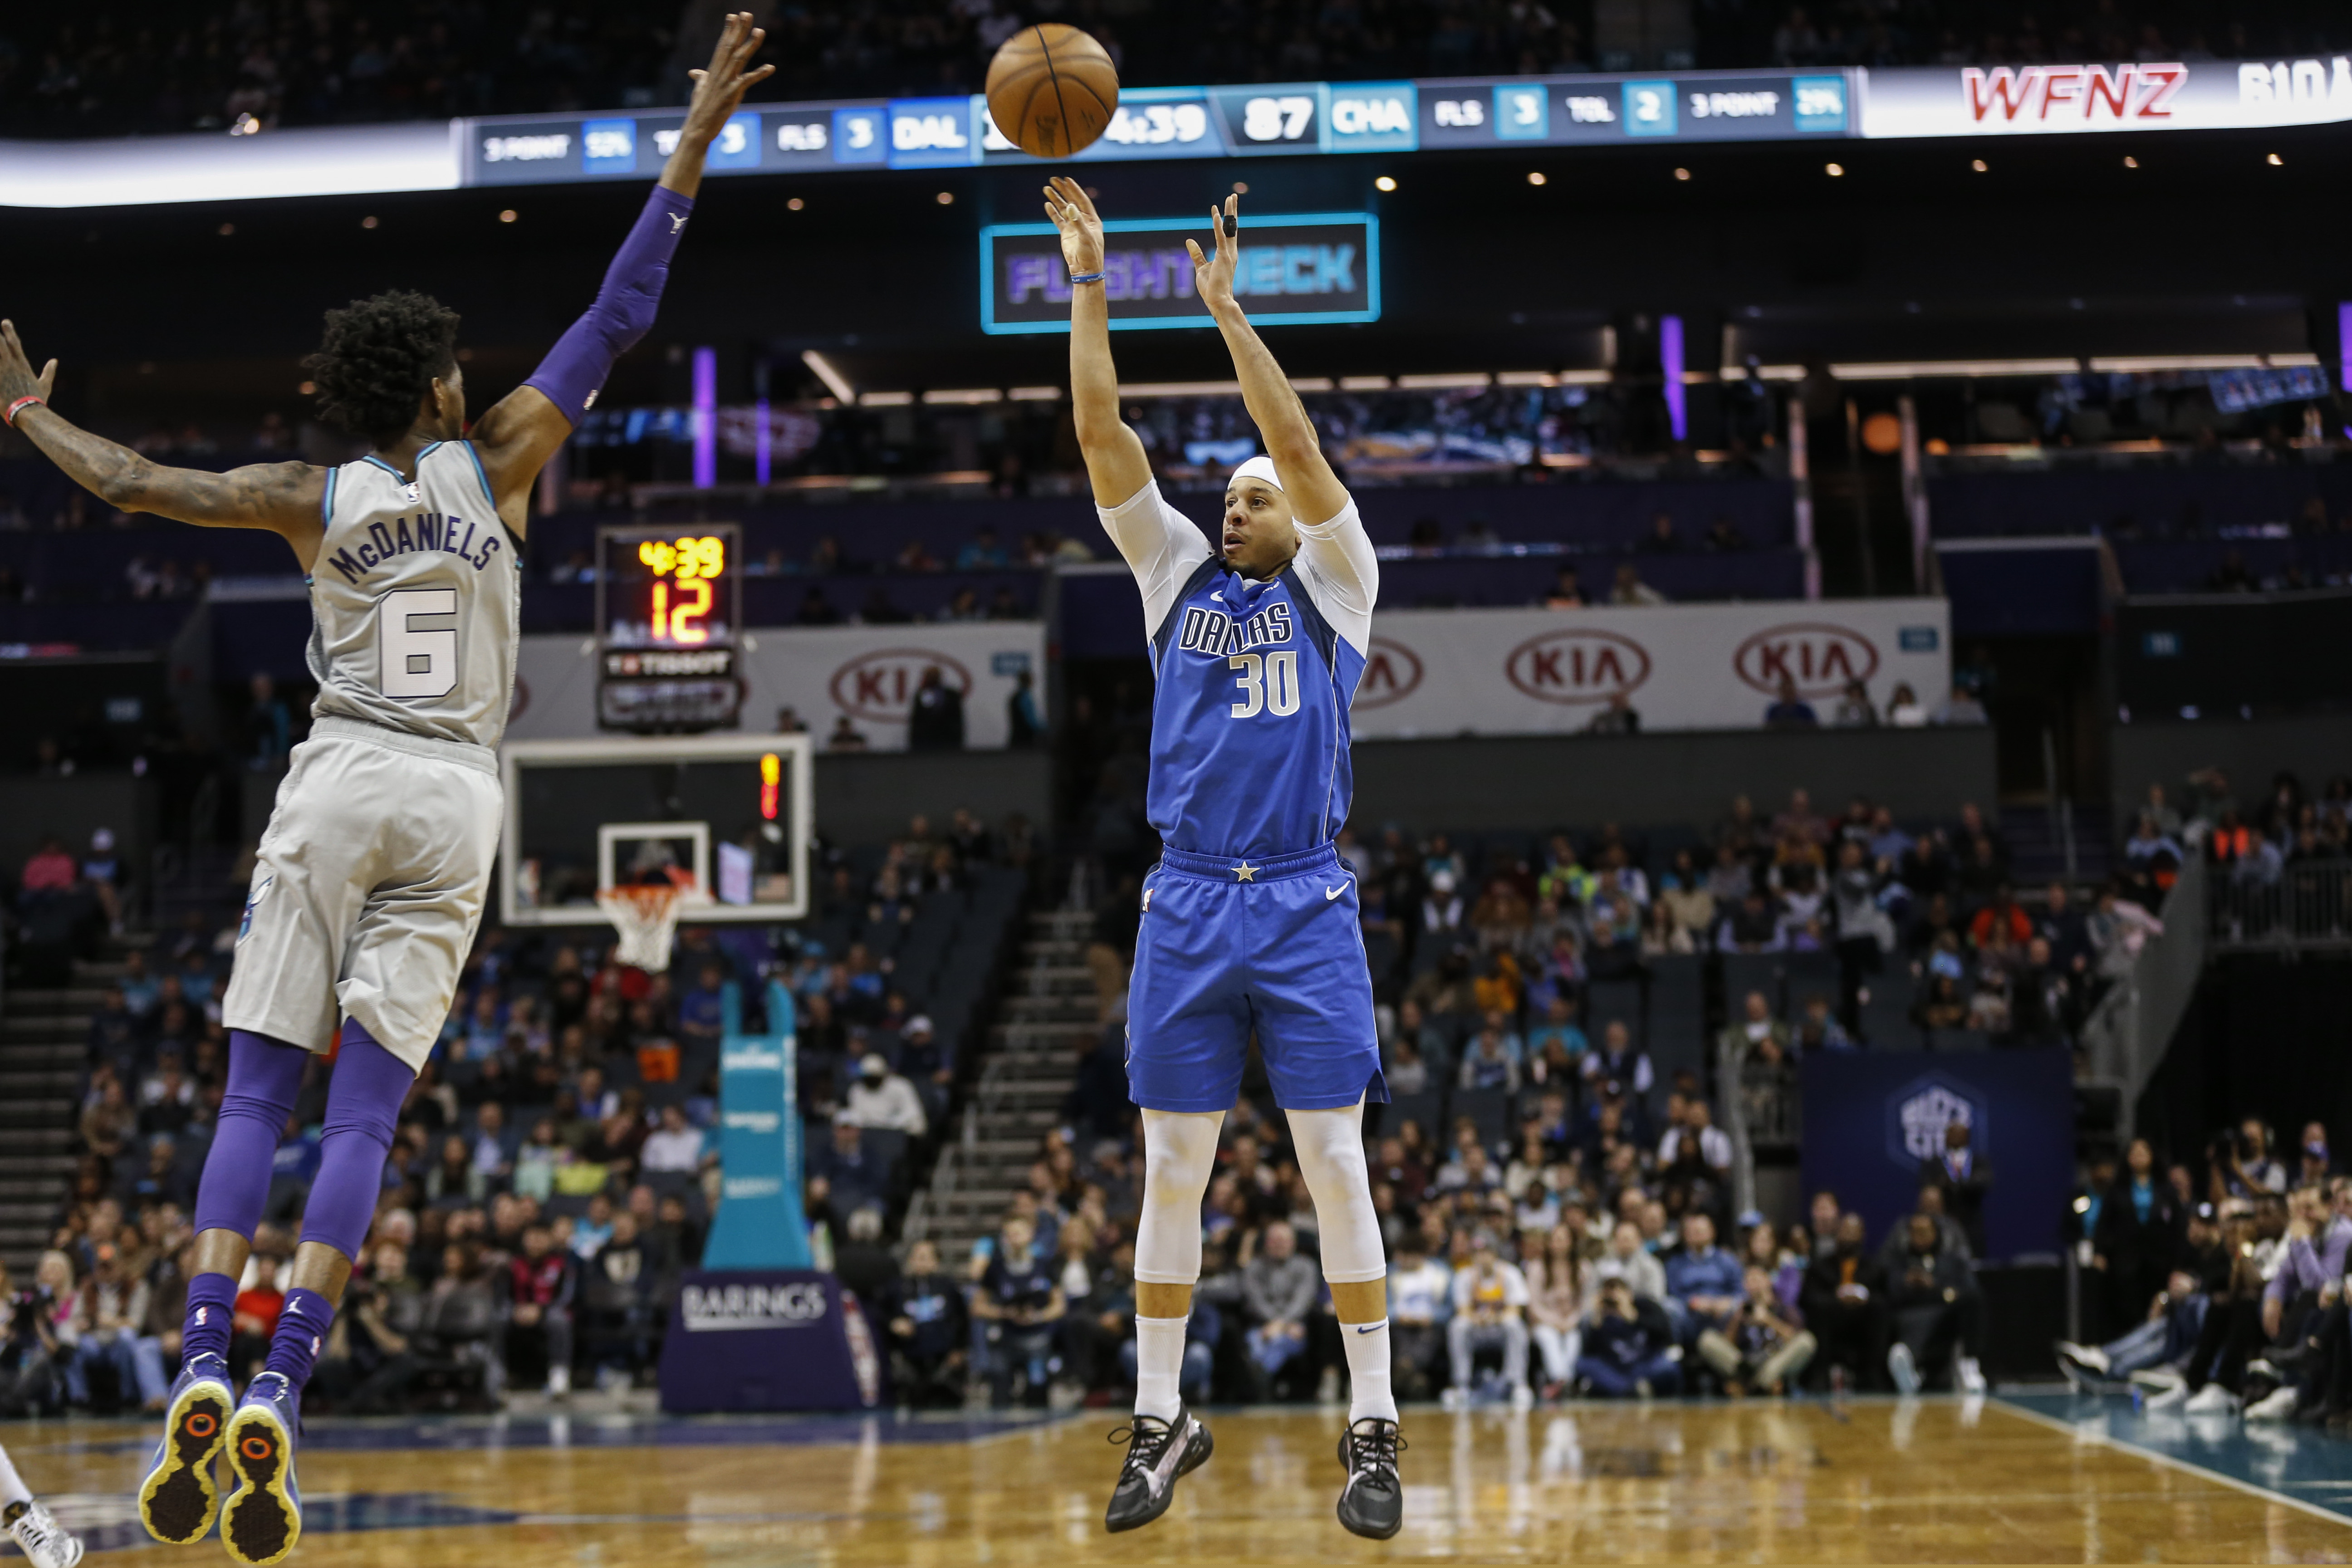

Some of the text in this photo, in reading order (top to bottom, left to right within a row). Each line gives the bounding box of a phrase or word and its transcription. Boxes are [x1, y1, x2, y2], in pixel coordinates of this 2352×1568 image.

[1961, 62, 2188, 123] WFNZ
[502, 132, 571, 160] POINT
[720, 122, 746, 154] 3
[777, 123, 828, 151] FLS
[847, 117, 874, 149] 3
[892, 115, 967, 150] DAL
[1243, 95, 1315, 142] 87
[1330, 98, 1411, 134] CHA
[1434, 99, 1485, 127] FLS
[1513, 93, 1540, 125] 3
[1636, 90, 1661, 122] 2
[1690, 92, 1710, 119] 3
[1710, 90, 1780, 118] POINT
[1005, 249, 1198, 305] FLGHT
[328, 513, 501, 585] McDANIELS
[639, 535, 724, 579] 4:39
[651, 576, 714, 644] 12
[1178, 601, 1293, 657] DALLAS
[378, 588, 458, 699] 6
[1531, 646, 1626, 688] KIA
[1760, 640, 1857, 682] KIA
[1228, 650, 1301, 718] 30
[681, 1282, 827, 1319] BARINGS
